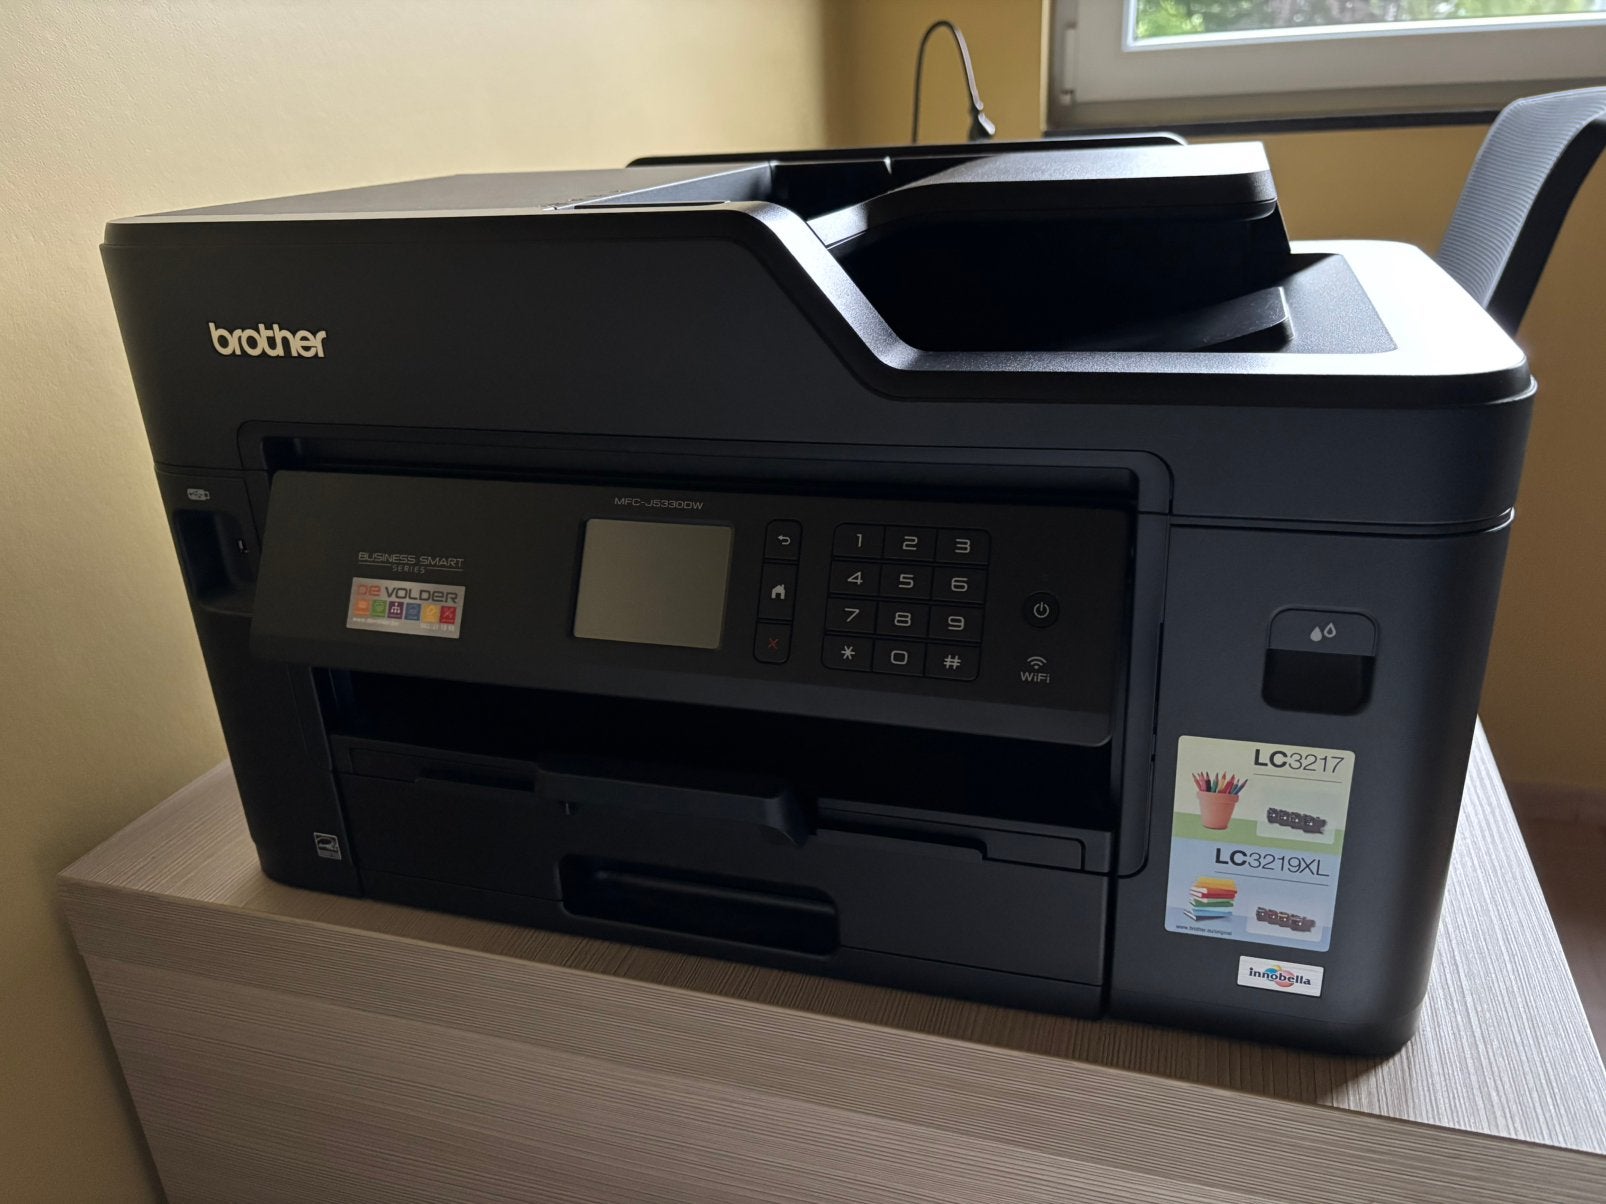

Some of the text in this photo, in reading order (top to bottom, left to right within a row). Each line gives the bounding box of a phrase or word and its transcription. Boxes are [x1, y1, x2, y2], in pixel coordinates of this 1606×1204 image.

[208, 322, 327, 358] brother
[614, 497, 704, 510] MFC-J5330DW
[856, 533, 971, 554] 1 2 3
[358, 551, 464, 568] BUSINESS SMART
[392, 565, 425, 574] SERIES
[847, 571, 968, 592] 4 5 6
[843, 607, 965, 630] 7 8 9
[890, 650, 908, 665] 0
[1020, 671, 1051, 684] WiFi
[1254, 748, 1345, 774] LC3217
[1215, 847, 1330, 877] LC3219XL
[1249, 967, 1311, 986] innobella
